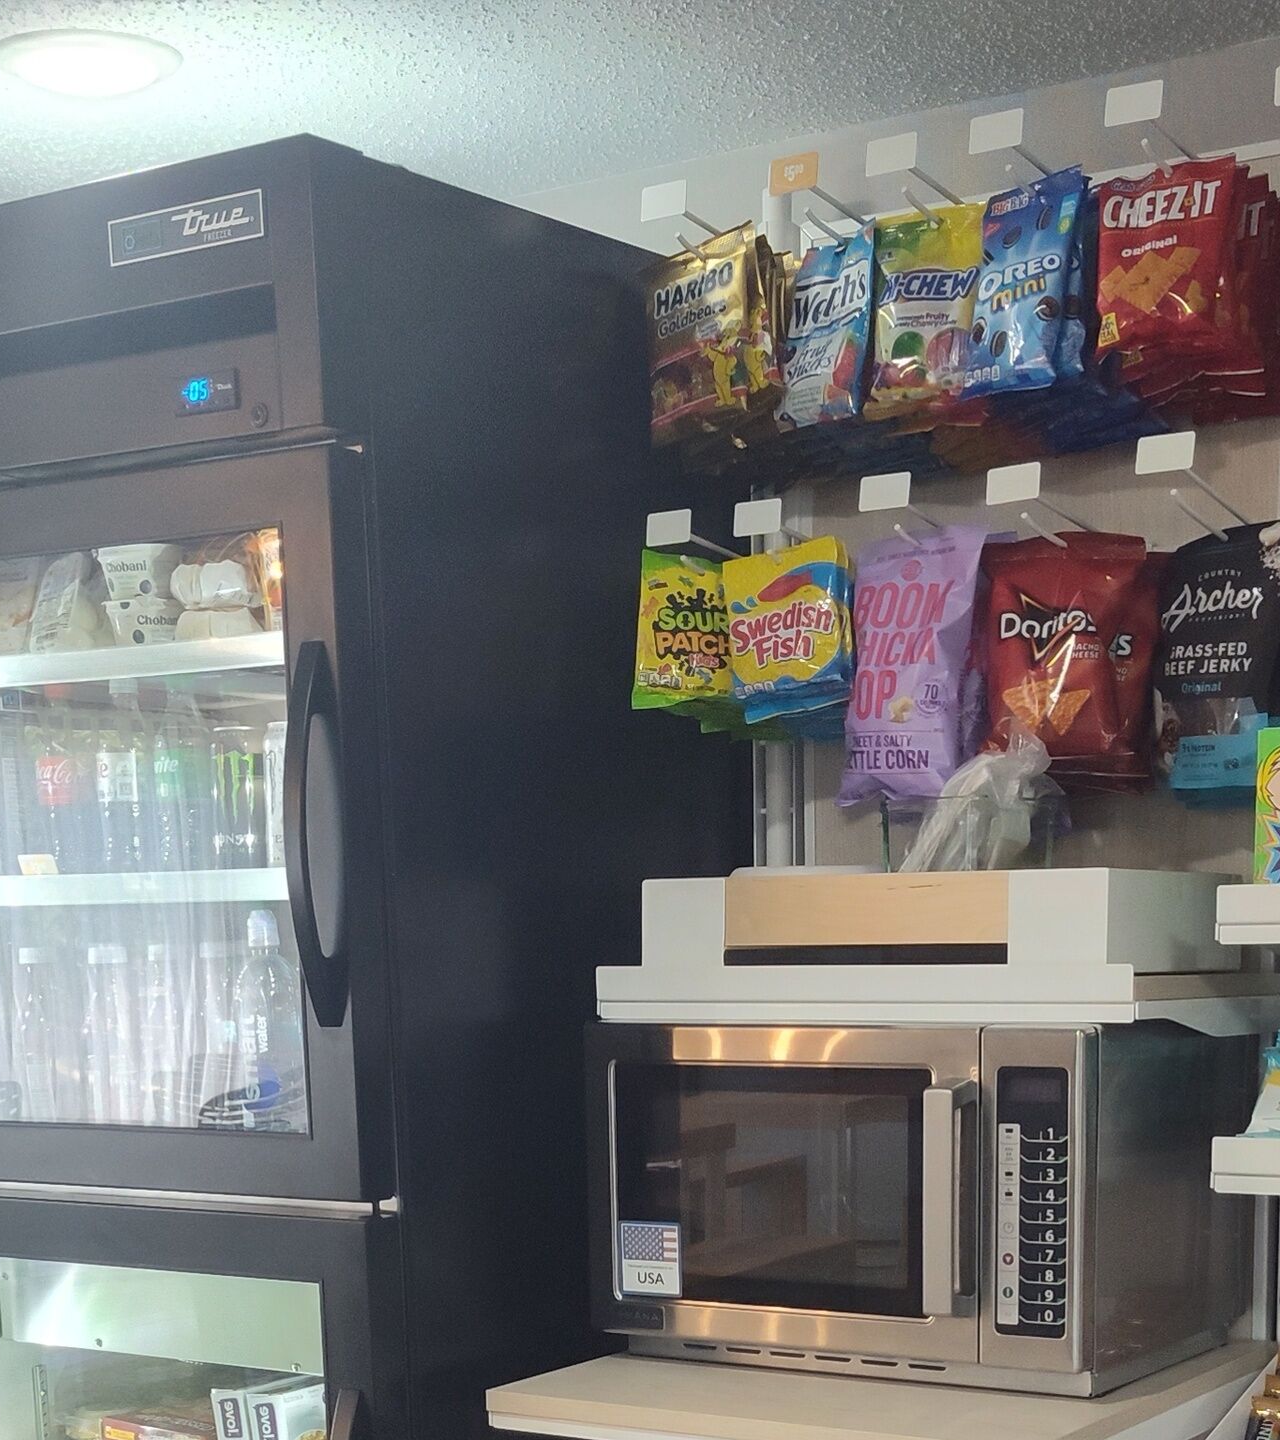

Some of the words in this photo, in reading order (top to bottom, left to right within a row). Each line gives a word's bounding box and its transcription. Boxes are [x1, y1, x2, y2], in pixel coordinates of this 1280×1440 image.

[203, 228, 233, 242] FREEZER
[978, 253, 1061, 301] OREO
[655, 261, 734, 318] HARIBO
[992, 274, 1046, 312] mini
[106, 560, 147, 573] Chobani
[1198, 568, 1242, 582] COUNTRY
[1161, 580, 1265, 633] Archer
[658, 608, 730, 633] SOUR
[730, 601, 833, 653] Swedish
[753, 629, 812, 668] Fish
[857, 626, 937, 667] HICKA
[1164, 660, 1196, 676] BEEF
[1199, 657, 1253, 674] JERKY
[923, 683, 939, 701] 70
[1181, 681, 1222, 694] Original
[874, 734, 883, 748] &
[883, 734, 913, 748] SALTY
[885, 749, 930, 769] CORN
[257, 1013, 269, 1053] water
[1047, 1127, 1054, 1140] 1
[1046, 1148, 1055, 1161] 2
[1046, 1168, 1055, 1181] 3
[1045, 1189, 1055, 1202] 4
[1045, 1209, 1055, 1222] 5
[1045, 1229, 1055, 1242] 6
[1045, 1250, 1054, 1262] 7
[637, 1271, 665, 1285] USA
[1045, 1270, 1054, 1282] 8
[1044, 1289, 1054, 1302] 9
[1044, 1310, 1054, 1322] 0
